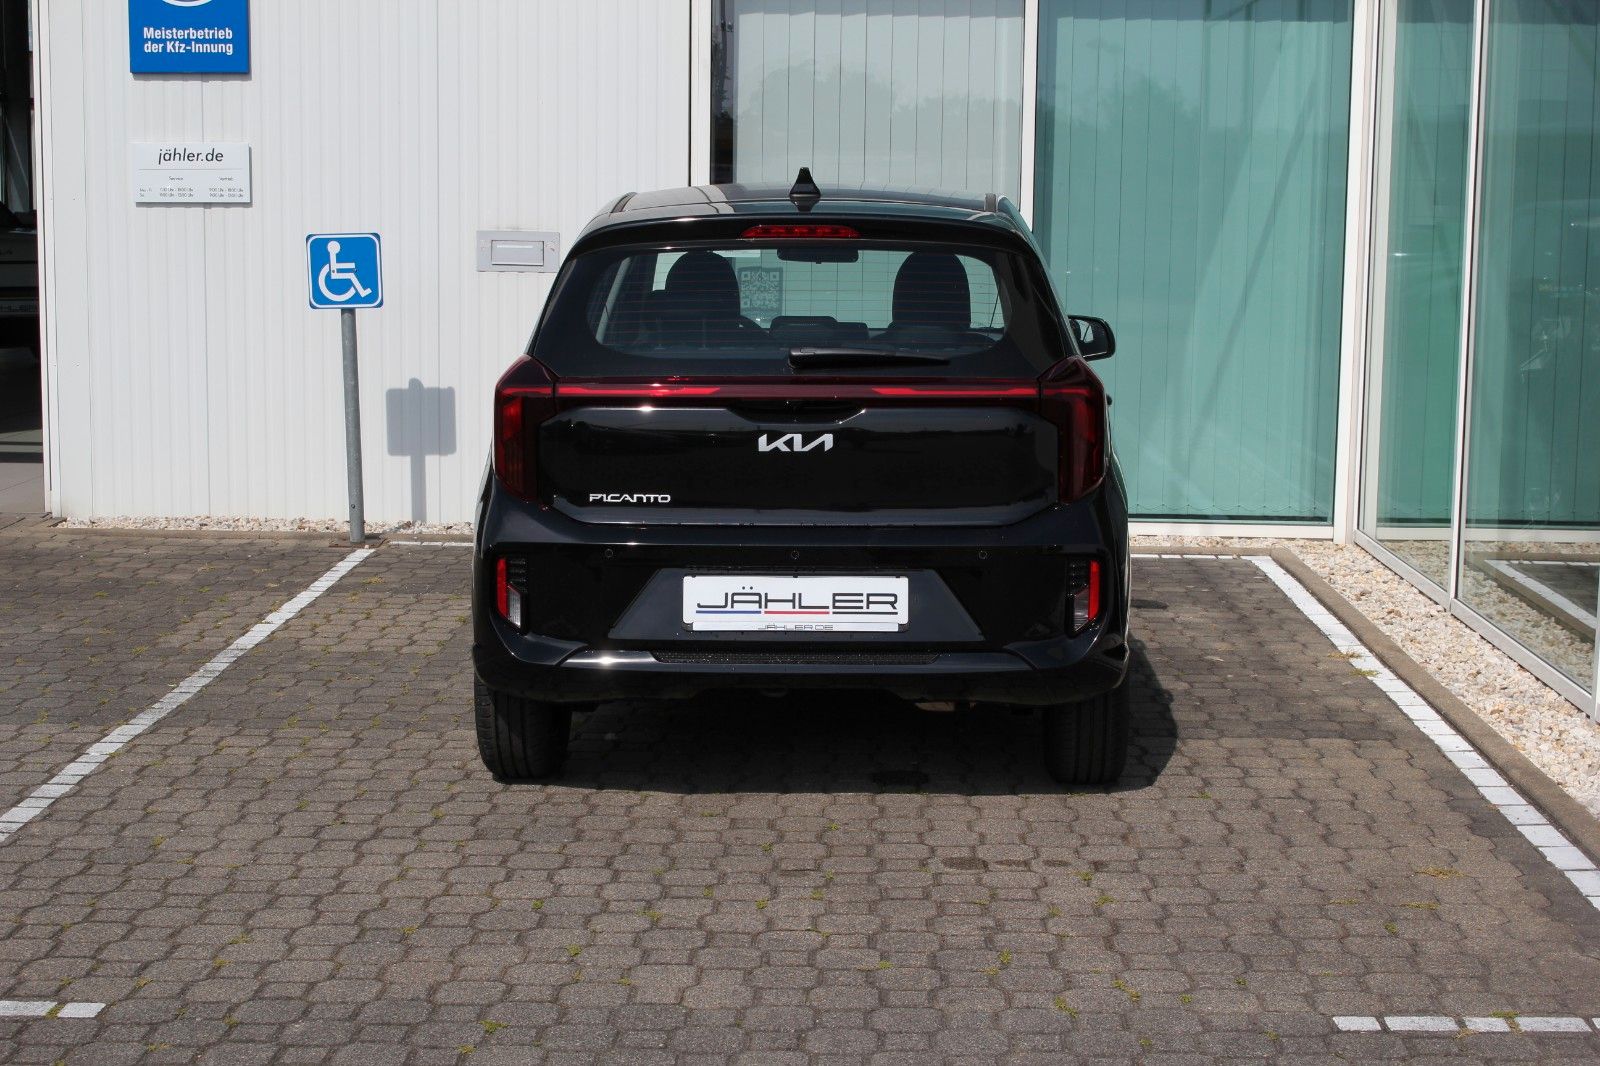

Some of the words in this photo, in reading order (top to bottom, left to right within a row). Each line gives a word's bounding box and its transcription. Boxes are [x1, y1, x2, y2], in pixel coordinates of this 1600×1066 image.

[143, 27, 233, 39] Meisterbetrieb
[144, 41, 164, 53] der
[166, 41, 233, 55] Kfz-Innung
[158, 147, 224, 165] jähler.de
[757, 433, 834, 452] KIA
[589, 493, 672, 503] PICANTO
[696, 586, 899, 610] JÄHLER
[758, 622, 834, 631] JÄHLERDE
